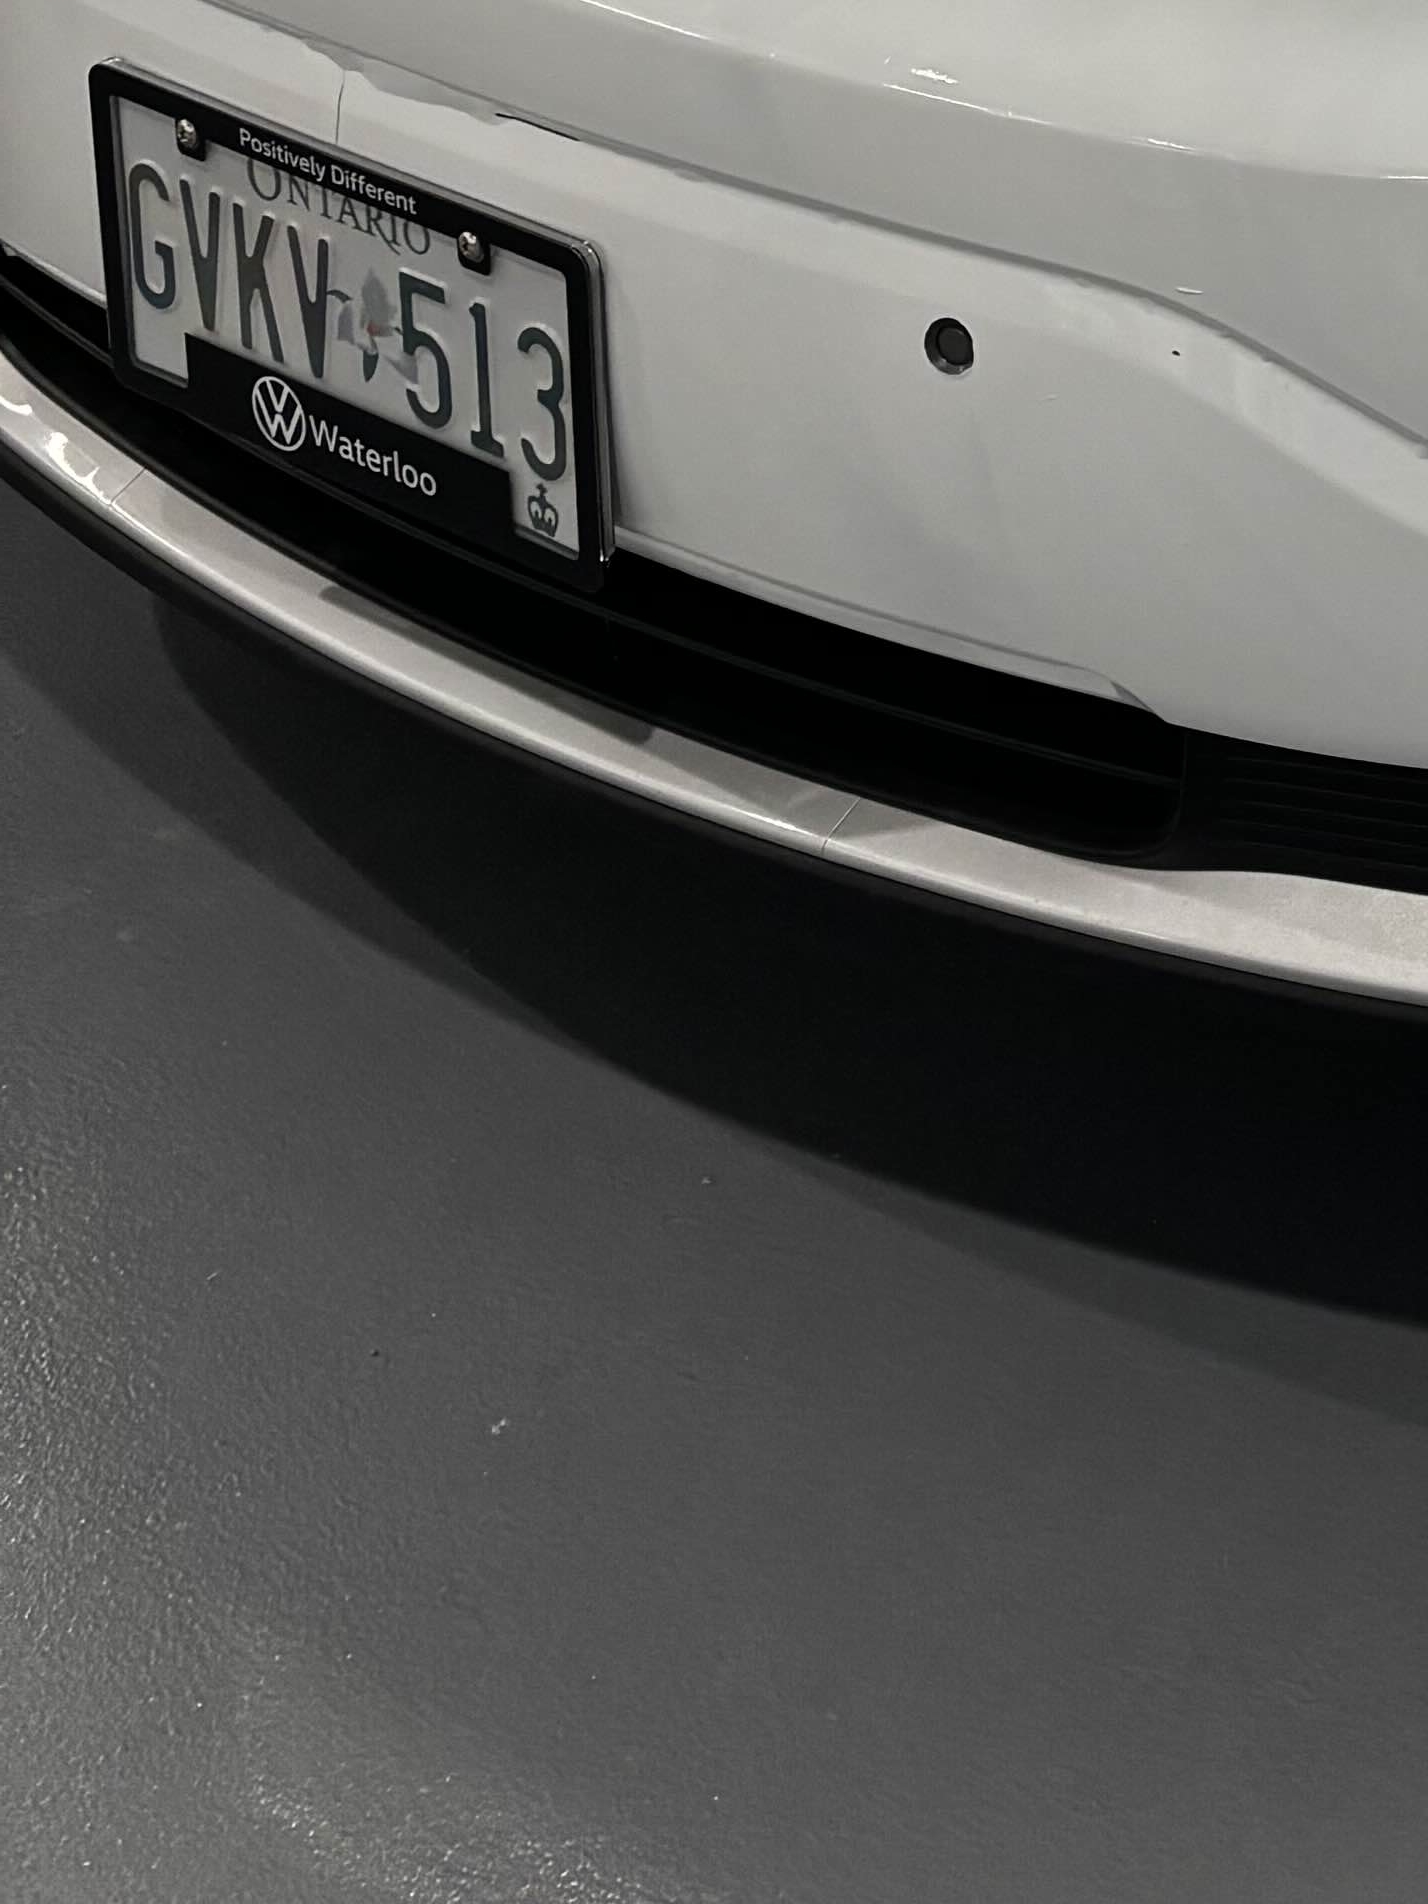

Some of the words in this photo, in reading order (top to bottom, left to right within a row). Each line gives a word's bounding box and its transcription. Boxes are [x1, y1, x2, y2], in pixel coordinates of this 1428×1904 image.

[239, 126, 326, 182] Positively
[331, 163, 417, 216] Different
[310, 415, 438, 497] Waterloo
